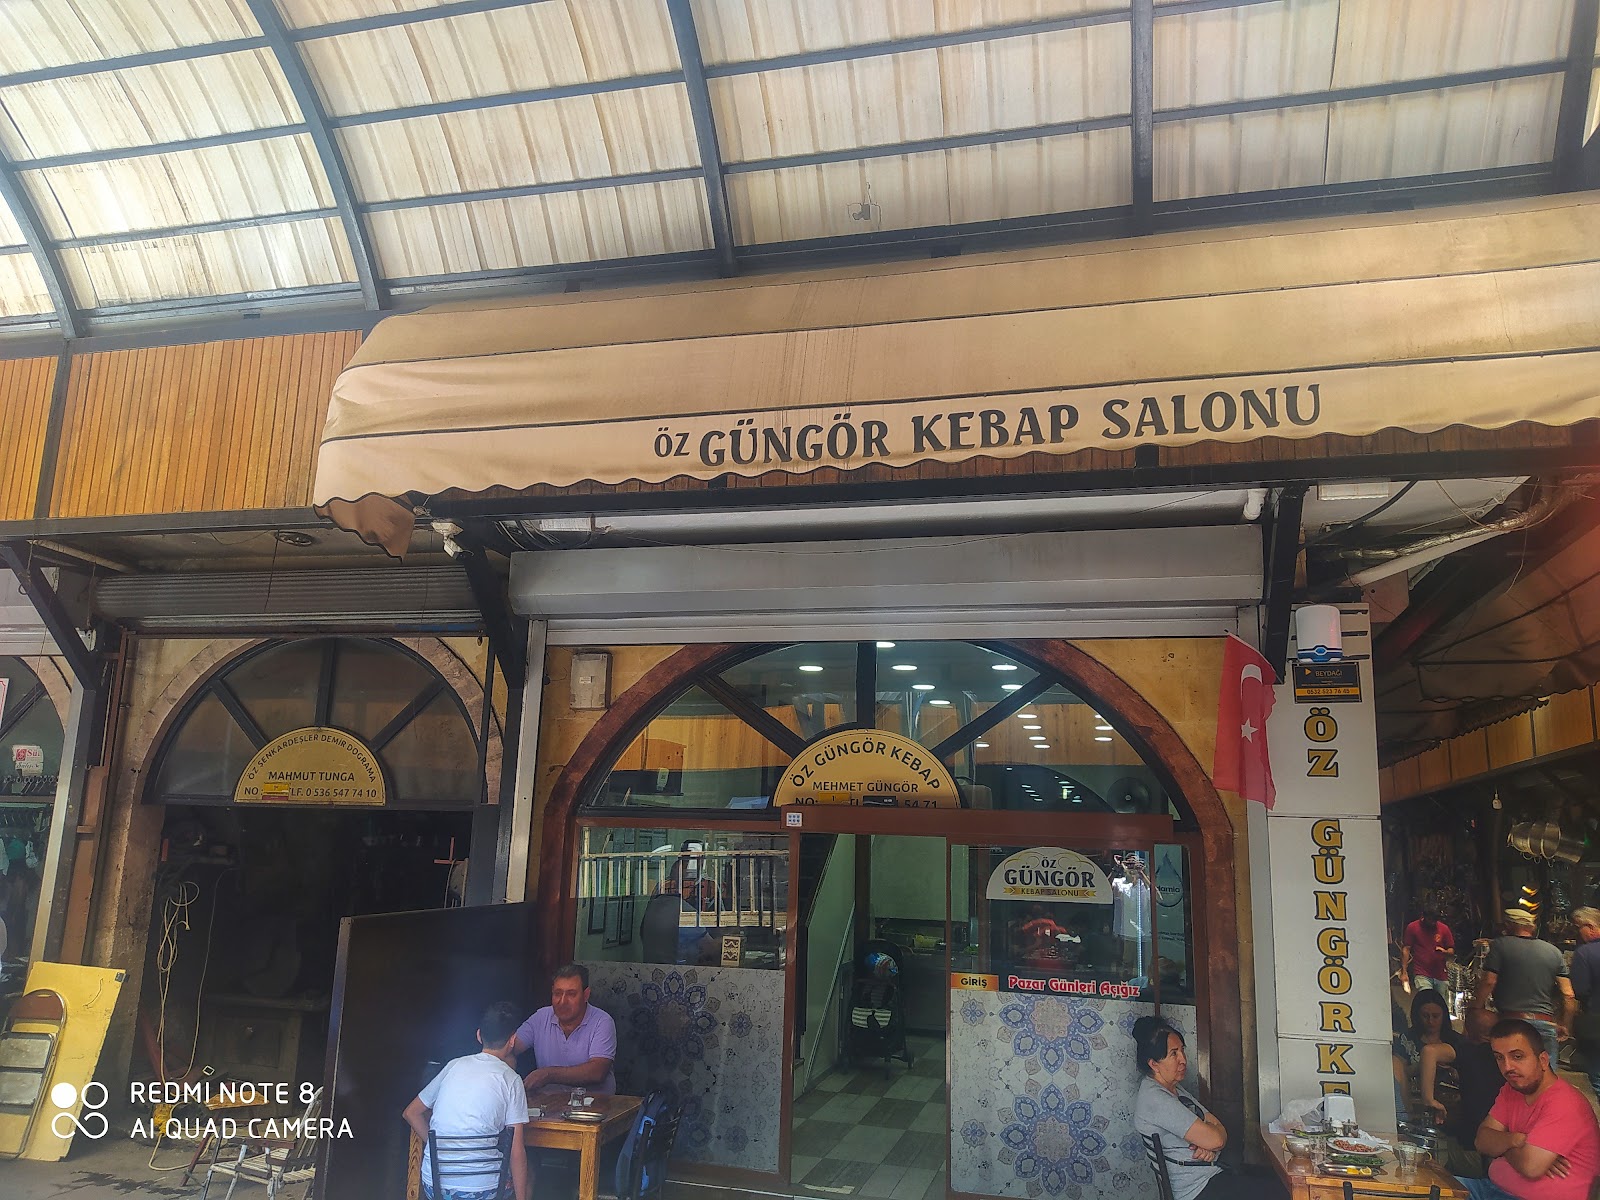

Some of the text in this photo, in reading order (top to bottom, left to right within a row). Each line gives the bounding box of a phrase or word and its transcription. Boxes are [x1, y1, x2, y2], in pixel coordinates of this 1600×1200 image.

[654, 383, 1320, 467] ÖZ GÜNGÖR KEBAP SALONU
[1303, 706, 1339, 778] ÖZ
[789, 737, 941, 791] ÖZ GÜNGÖR KEBAP
[247, 767, 259, 780] ÖZ
[268, 771, 355, 782] MAHMUT TUNGA
[306, 787, 312, 797] 0
[314, 788, 331, 797] 536
[333, 788, 349, 798] 547
[352, 788, 363, 798] 74
[366, 788, 377, 798] 10
[812, 779, 919, 793] MEHMET GÜNGÖR
[1041, 856, 1057, 869] ÖZ
[1004, 865, 1096, 888] GÜNGÖR
[1021, 887, 1079, 897] KEBAP SALONU
[1311, 818, 1357, 1034] GÜNGÖR
[960, 976, 988, 988] GİRİŞ
[1008, 975, 1140, 998] Pazar Günleri Açığız
